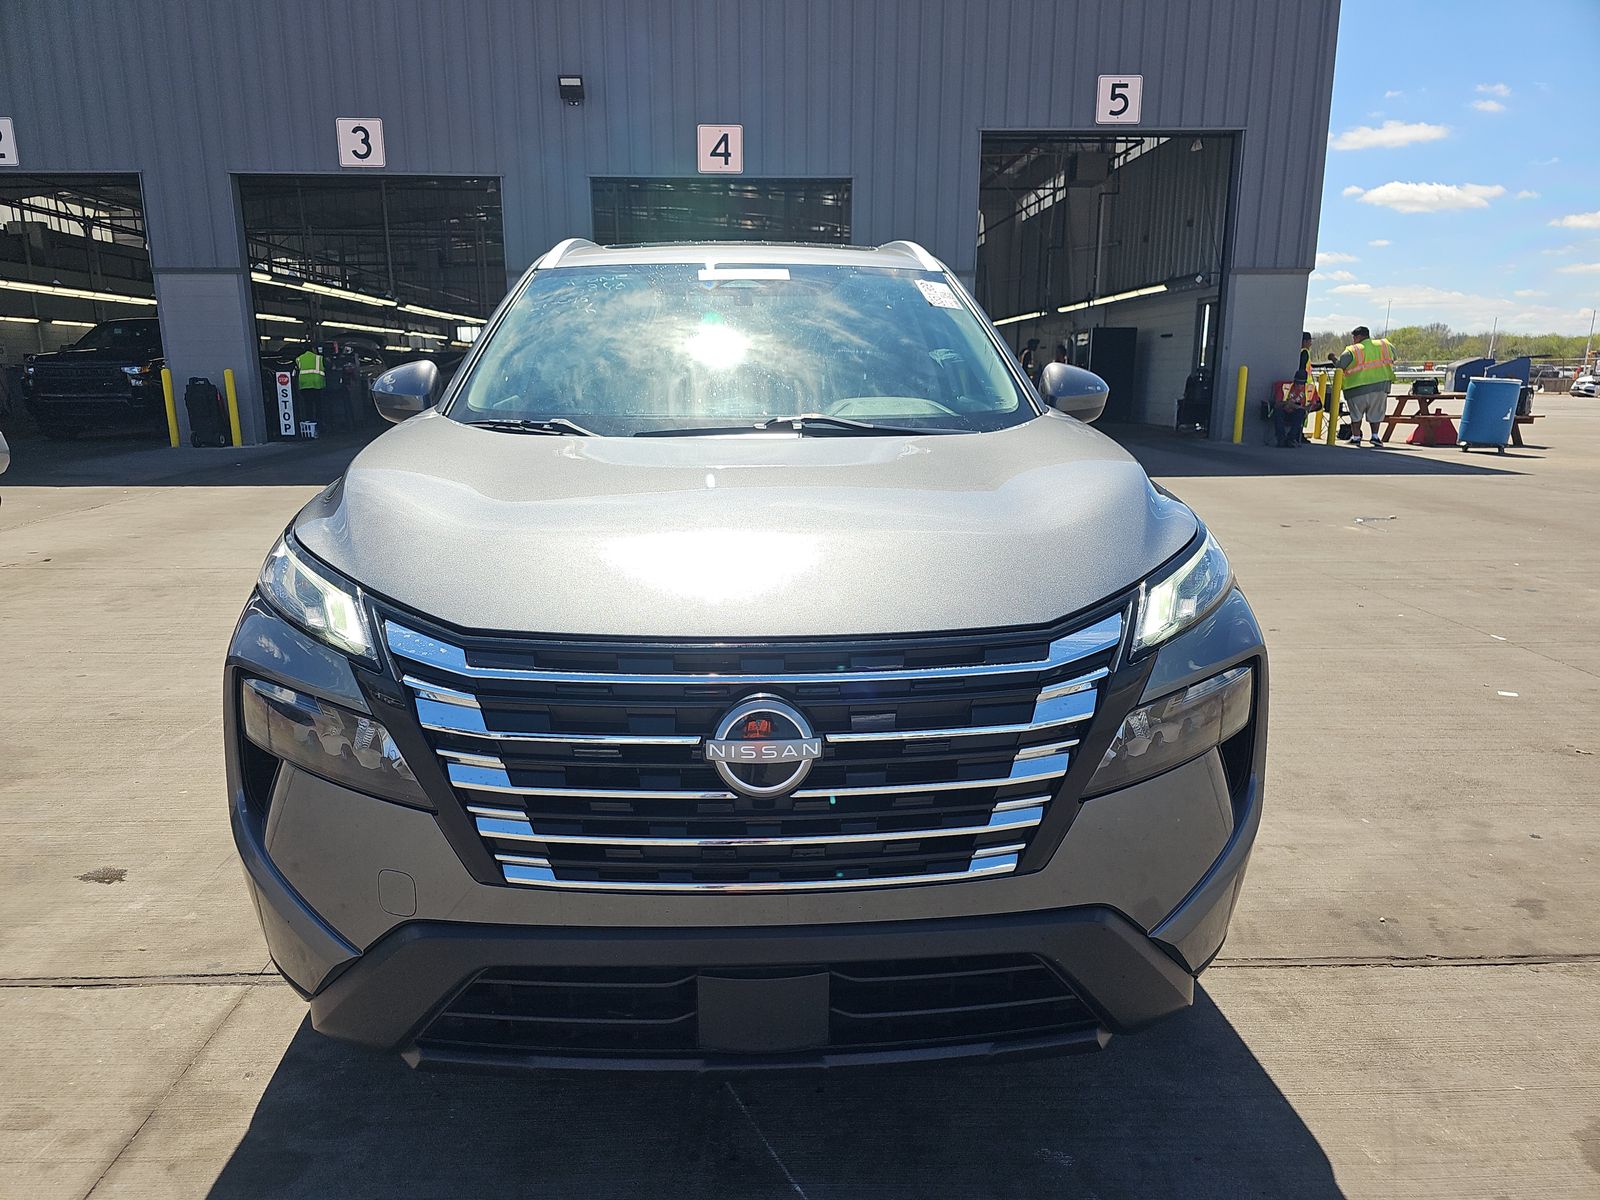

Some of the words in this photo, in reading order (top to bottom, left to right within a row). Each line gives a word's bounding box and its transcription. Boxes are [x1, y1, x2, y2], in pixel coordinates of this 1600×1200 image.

[1109, 83, 1129, 116] 5
[351, 125, 372, 160] 3
[710, 133, 731, 165] 4
[281, 388, 292, 433] STOP
[709, 742, 818, 759] NISSAN
